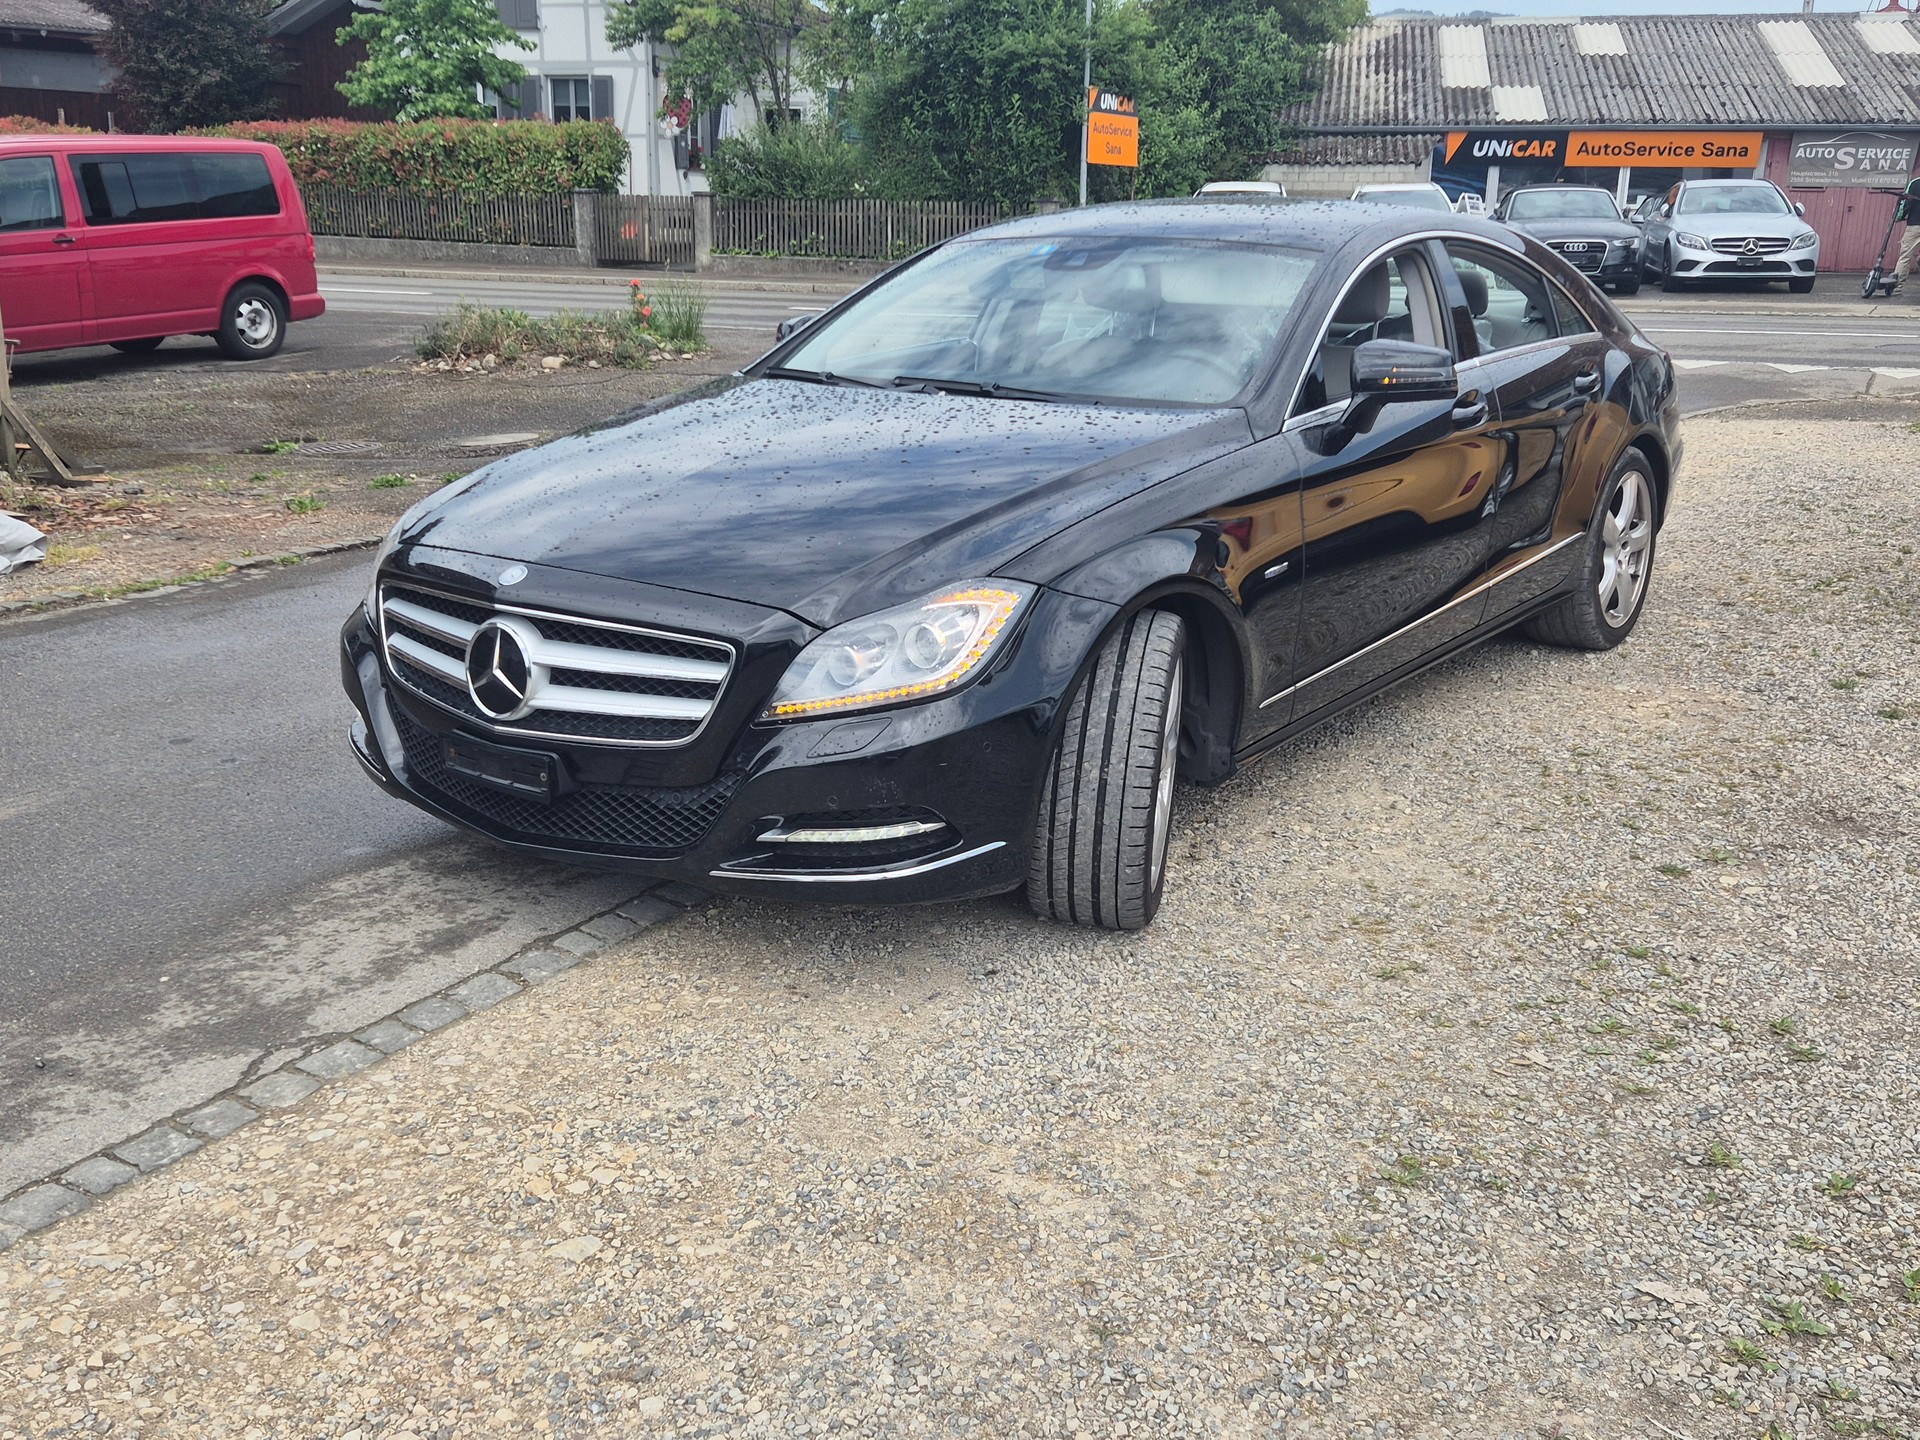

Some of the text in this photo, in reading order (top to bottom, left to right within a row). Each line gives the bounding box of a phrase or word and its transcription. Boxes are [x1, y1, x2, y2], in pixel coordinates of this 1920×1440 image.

[1093, 121, 1133, 137] AutoService
[1105, 142, 1122, 155] Sana
[1576, 141, 1749, 158] AutoService Sana
